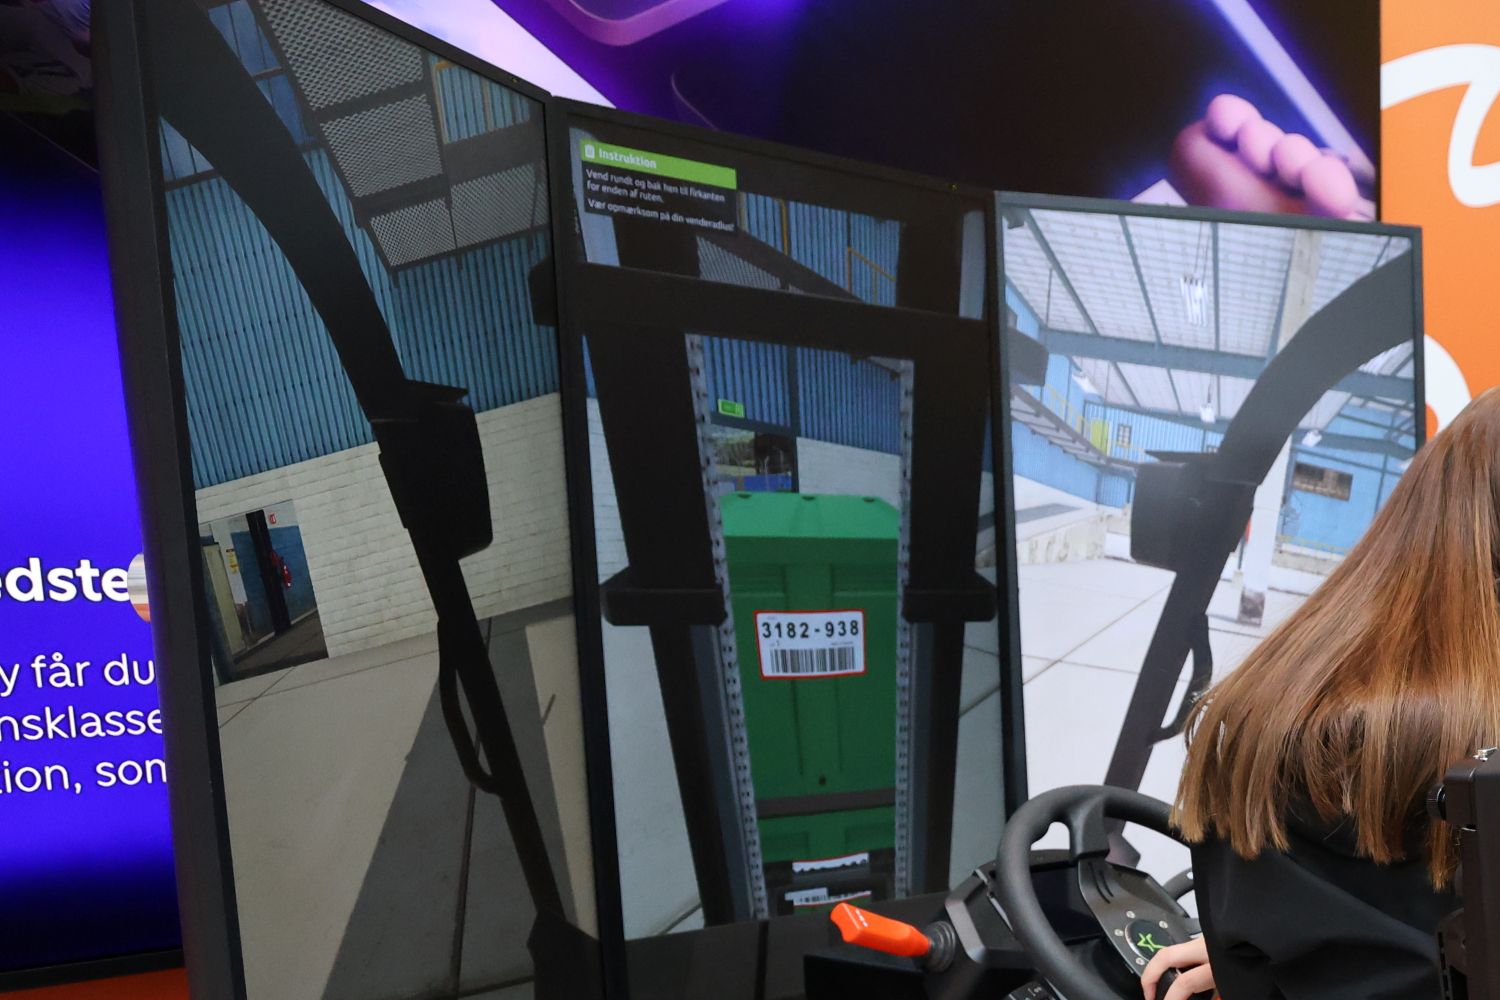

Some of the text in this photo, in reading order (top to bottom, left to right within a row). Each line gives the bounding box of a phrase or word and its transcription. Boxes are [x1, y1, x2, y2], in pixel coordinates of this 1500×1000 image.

[586, 168, 609, 181] Vend
[634, 180, 646, 190] og
[587, 180, 600, 191] for
[0, 556, 131, 603] dste
[762, 620, 859, 639] 3182-938
[30, 651, 91, 688] får
[103, 652, 156, 686] du
[0, 760, 82, 795] ion,
